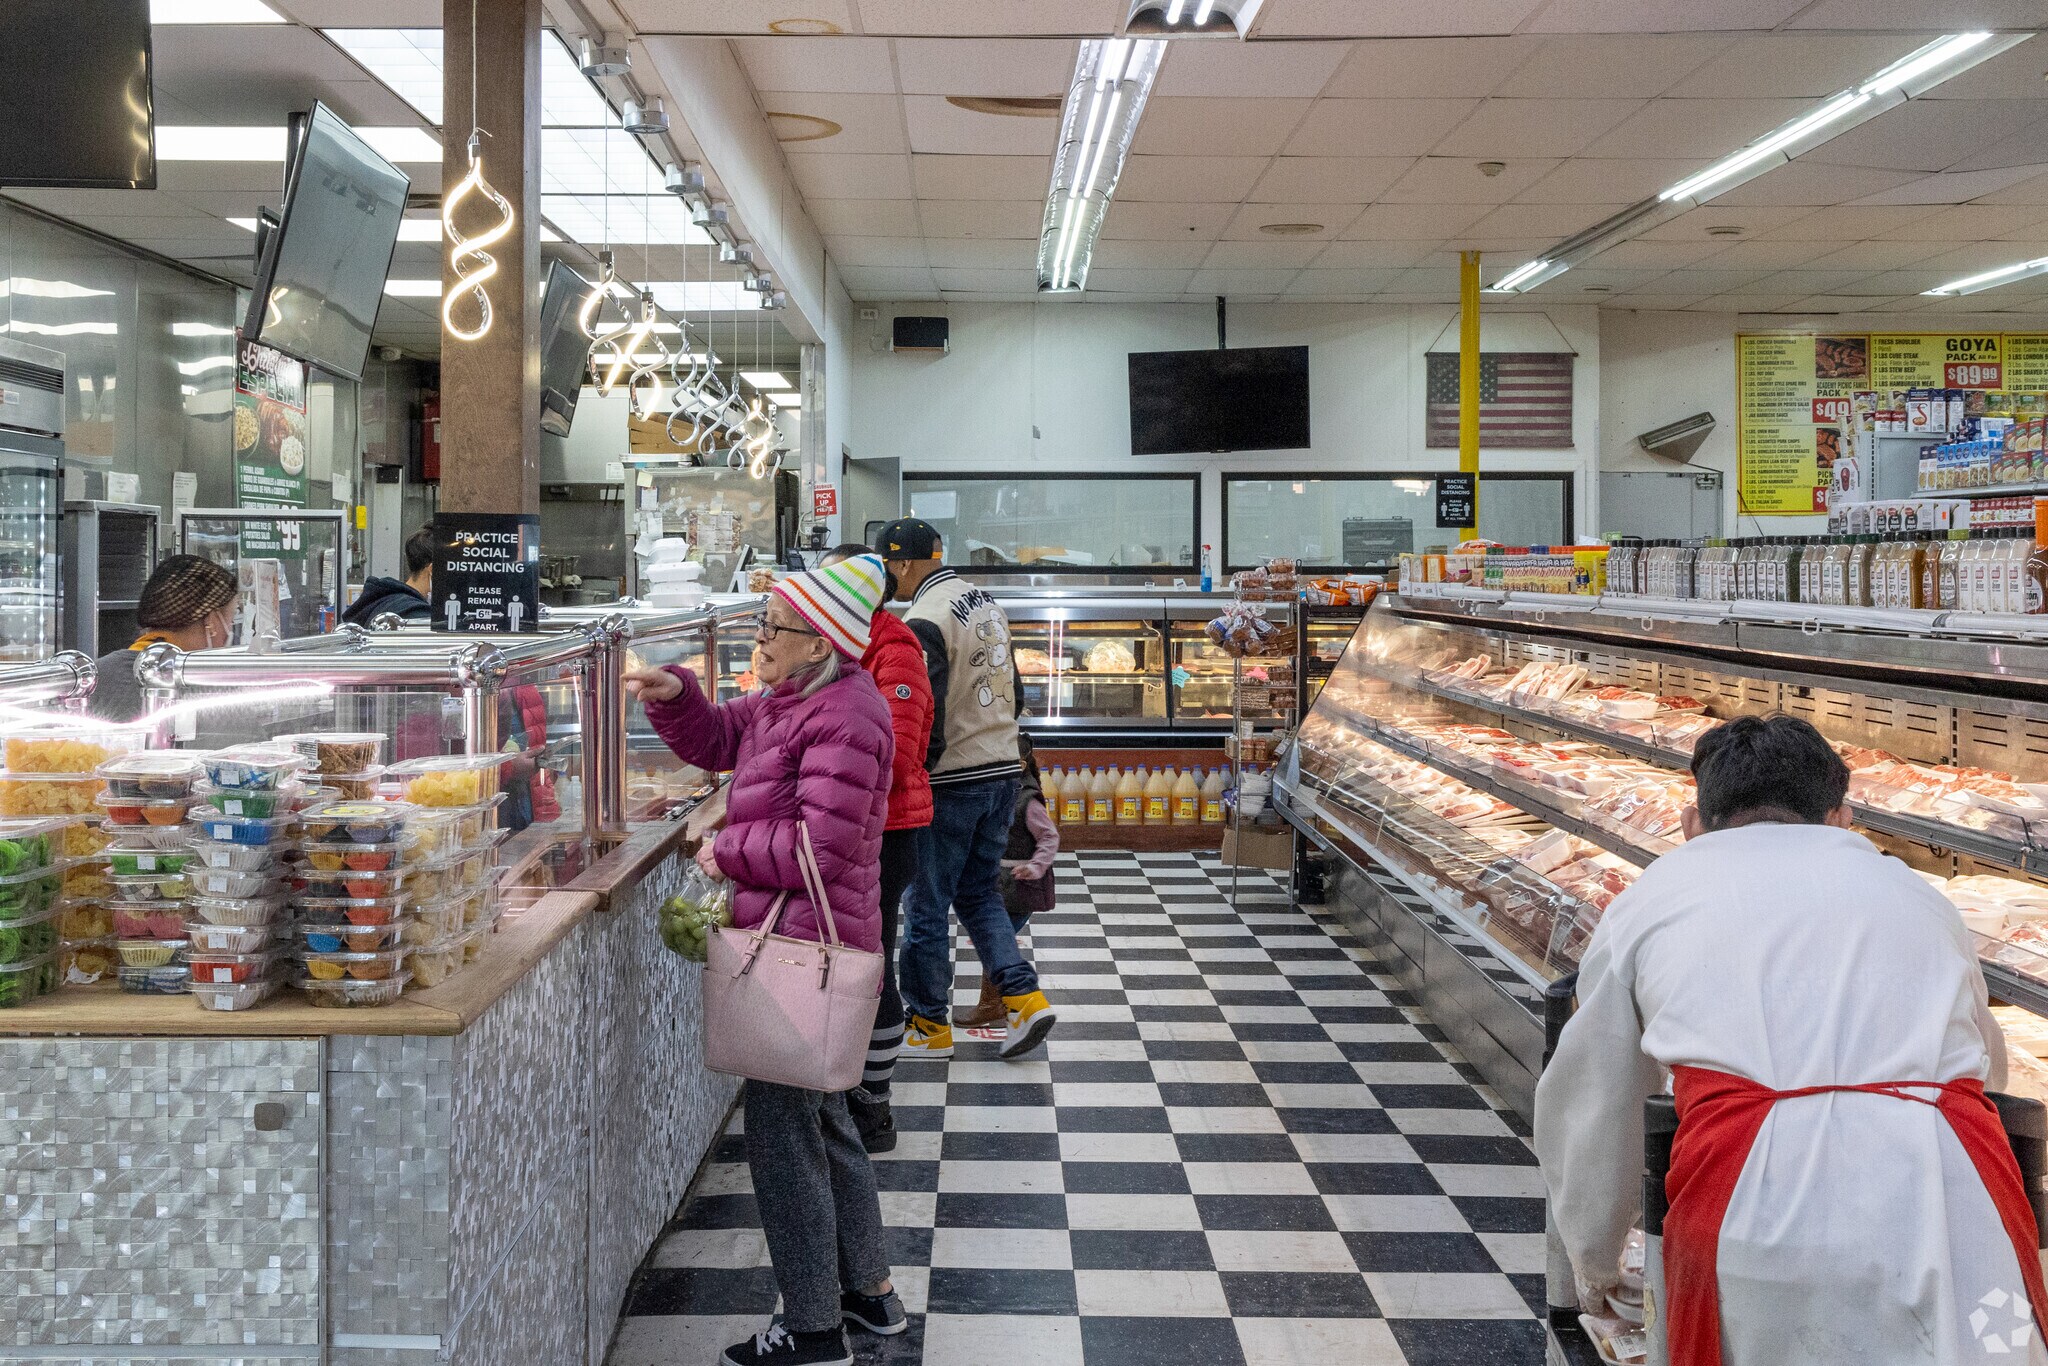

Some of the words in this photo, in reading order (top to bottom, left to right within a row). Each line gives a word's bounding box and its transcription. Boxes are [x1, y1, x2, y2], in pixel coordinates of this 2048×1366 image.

[1946, 338, 1996, 352] GOYA
[1816, 381, 1837, 389] ACADEMY
[1837, 381, 1852, 389] PICNIC
[1853, 381, 1868, 389] FAMILY
[455, 532, 519, 544] PRACTICE
[462, 547, 510, 558] SOCIAL
[446, 561, 525, 573] DISTANCING
[468, 586, 502, 595] PLEASE
[467, 597, 502, 605] REMAIN
[468, 623, 499, 632] APART,
